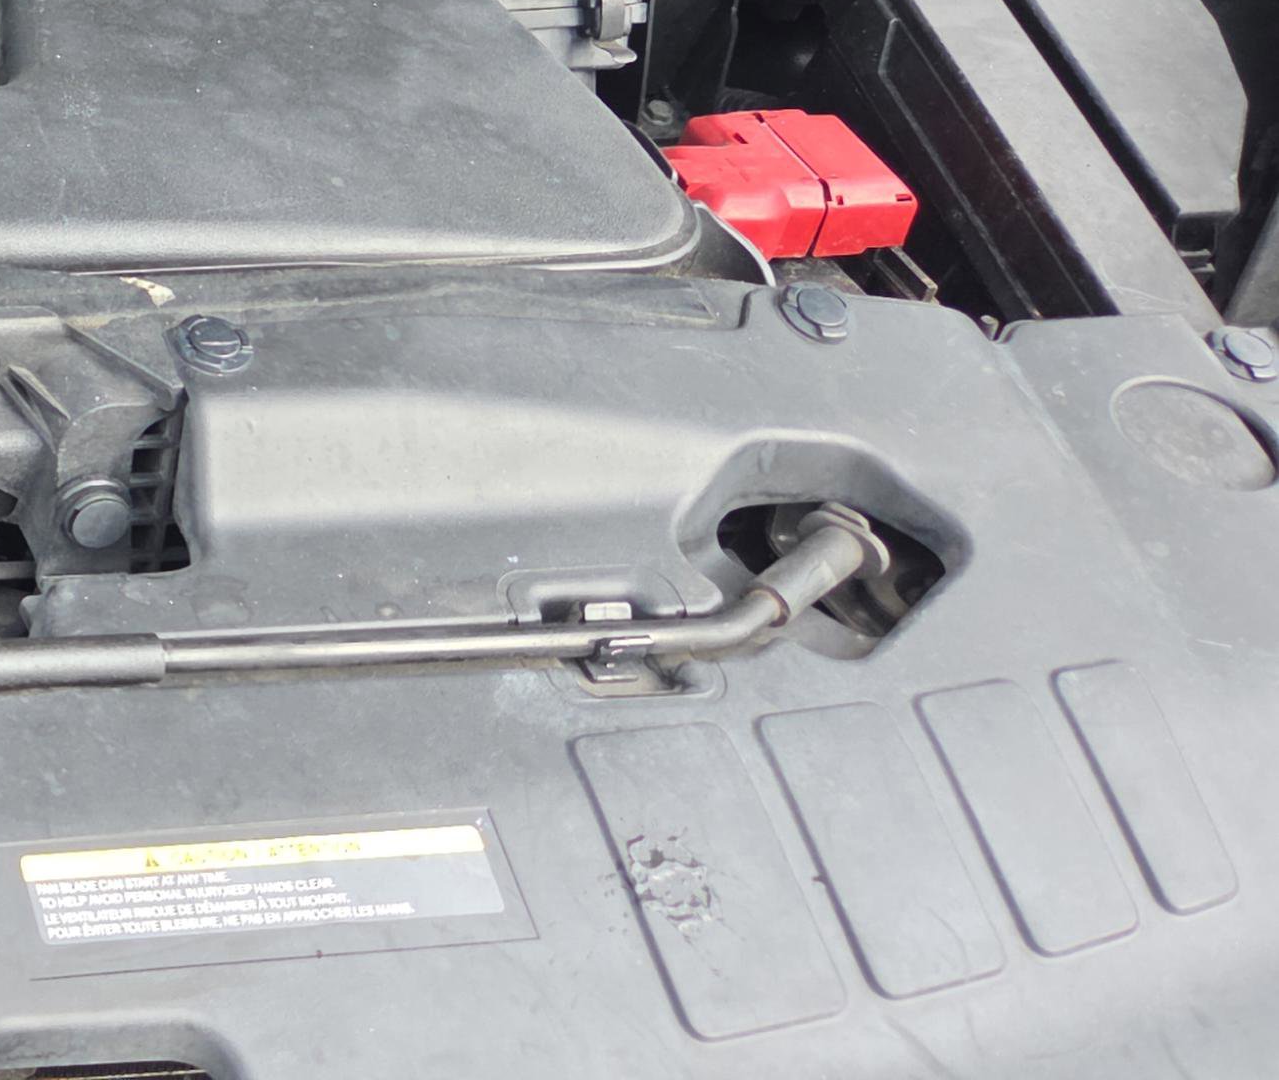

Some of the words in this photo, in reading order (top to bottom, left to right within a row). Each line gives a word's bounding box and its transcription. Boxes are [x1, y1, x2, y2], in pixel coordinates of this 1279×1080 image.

[35, 882, 58, 895] FAN
[59, 880, 97, 894] BLADE
[98, 878, 124, 892] CAN
[125, 876, 160, 890] START
[162, 875, 176, 887] AT
[177, 873, 199, 885] ANY
[201, 871, 231, 883] TIME.
[39, 896, 56, 909] TO
[58, 894, 87, 908] HELP
[89, 892, 123, 906] AVOID
[124, 889, 185, 903] PERSONAL
[255, 881, 295, 894] HANDS
[296, 877, 336, 891] CLEAR.
[43, 914, 60, 926] LE
[60, 908, 132, 924] VENTILATEUR
[133, 905, 177, 920] RISQUE
[178, 904, 195, 916] DE
[258, 896, 269, 911] À
[269, 895, 297, 909] TOUT
[299, 892, 351, 907] MOMENT.
[46, 926, 82, 940] POUR
[123, 920, 160, 934] TOUTE
[224, 914, 241, 926] NE
[242, 913, 263, 926] PAS
[265, 911, 281, 924] EN
[283, 907, 352, 922] APPROCHER
[353, 904, 375, 918] LES
